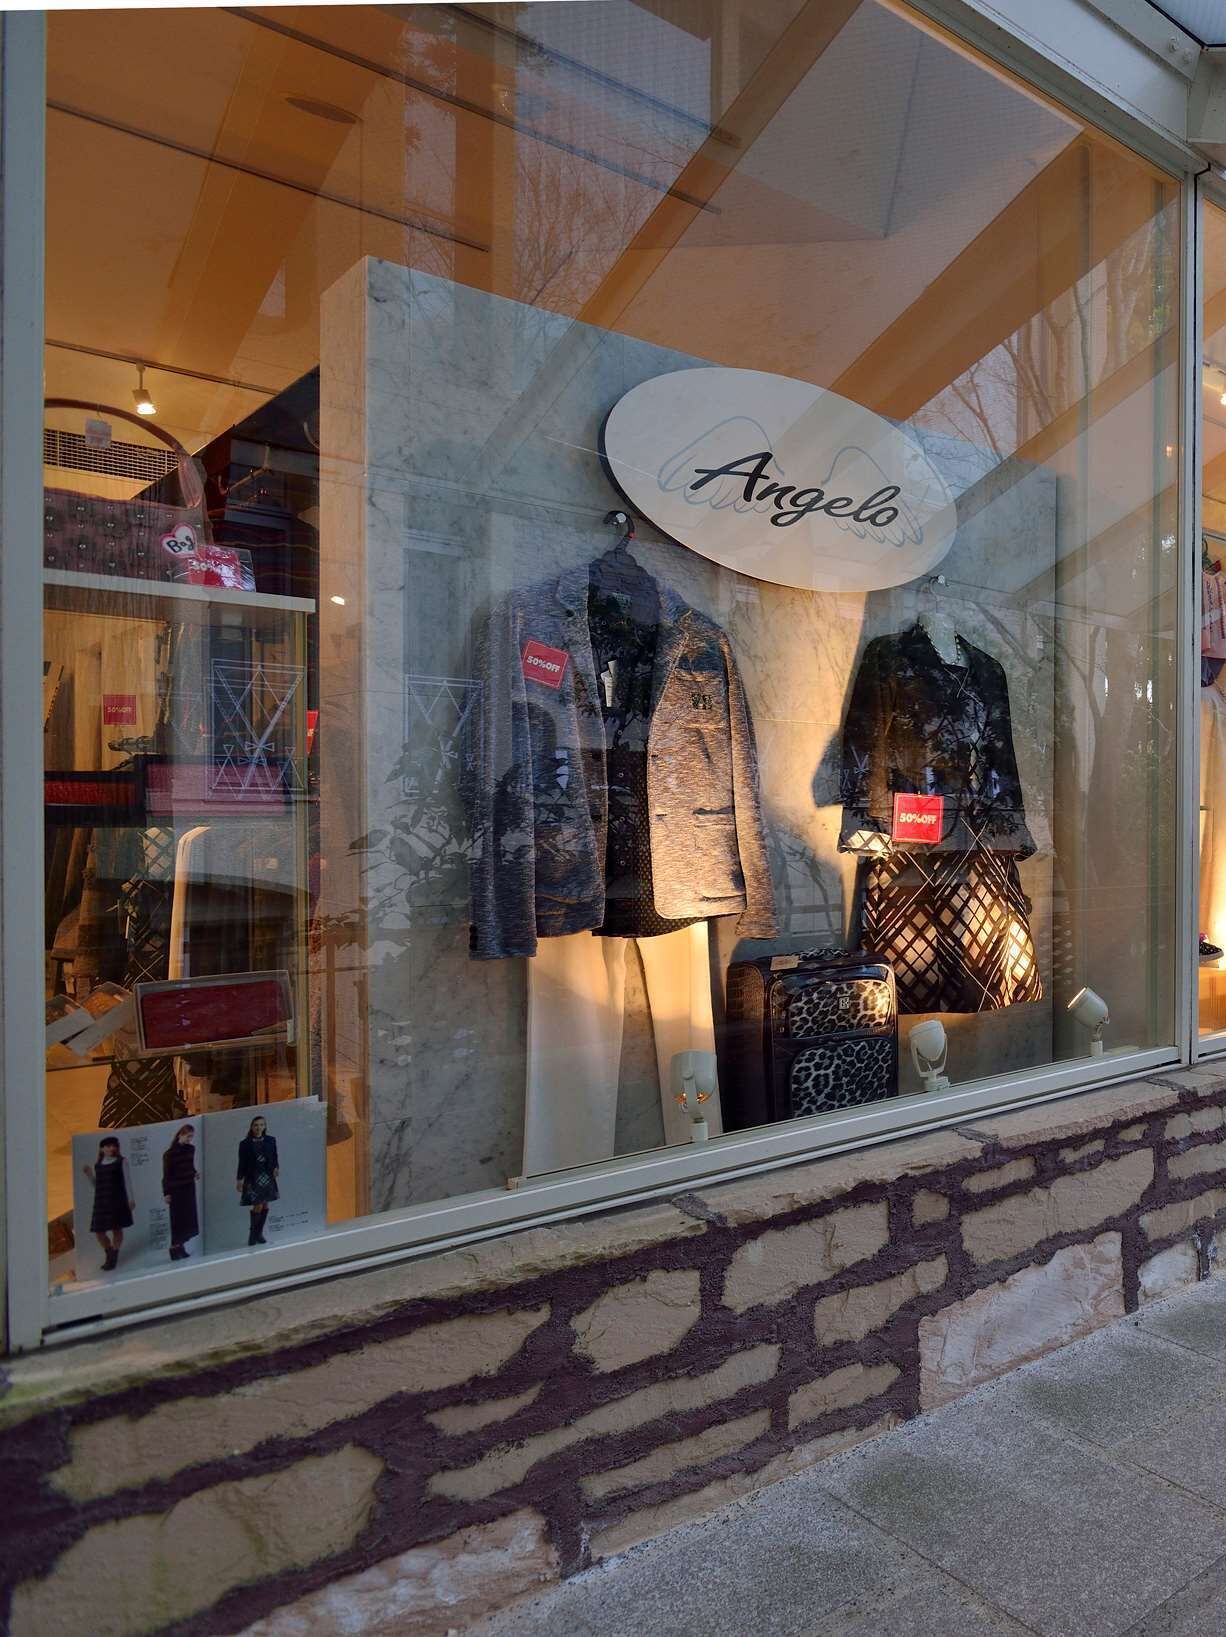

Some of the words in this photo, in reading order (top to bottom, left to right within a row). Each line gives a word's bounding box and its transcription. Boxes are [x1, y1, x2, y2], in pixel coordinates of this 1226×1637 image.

[689, 451, 901, 527] Angelo
[166, 535, 195, 553] Bag
[526, 655, 561, 673] 50%OFF
[899, 812, 937, 825] 50%OFF
